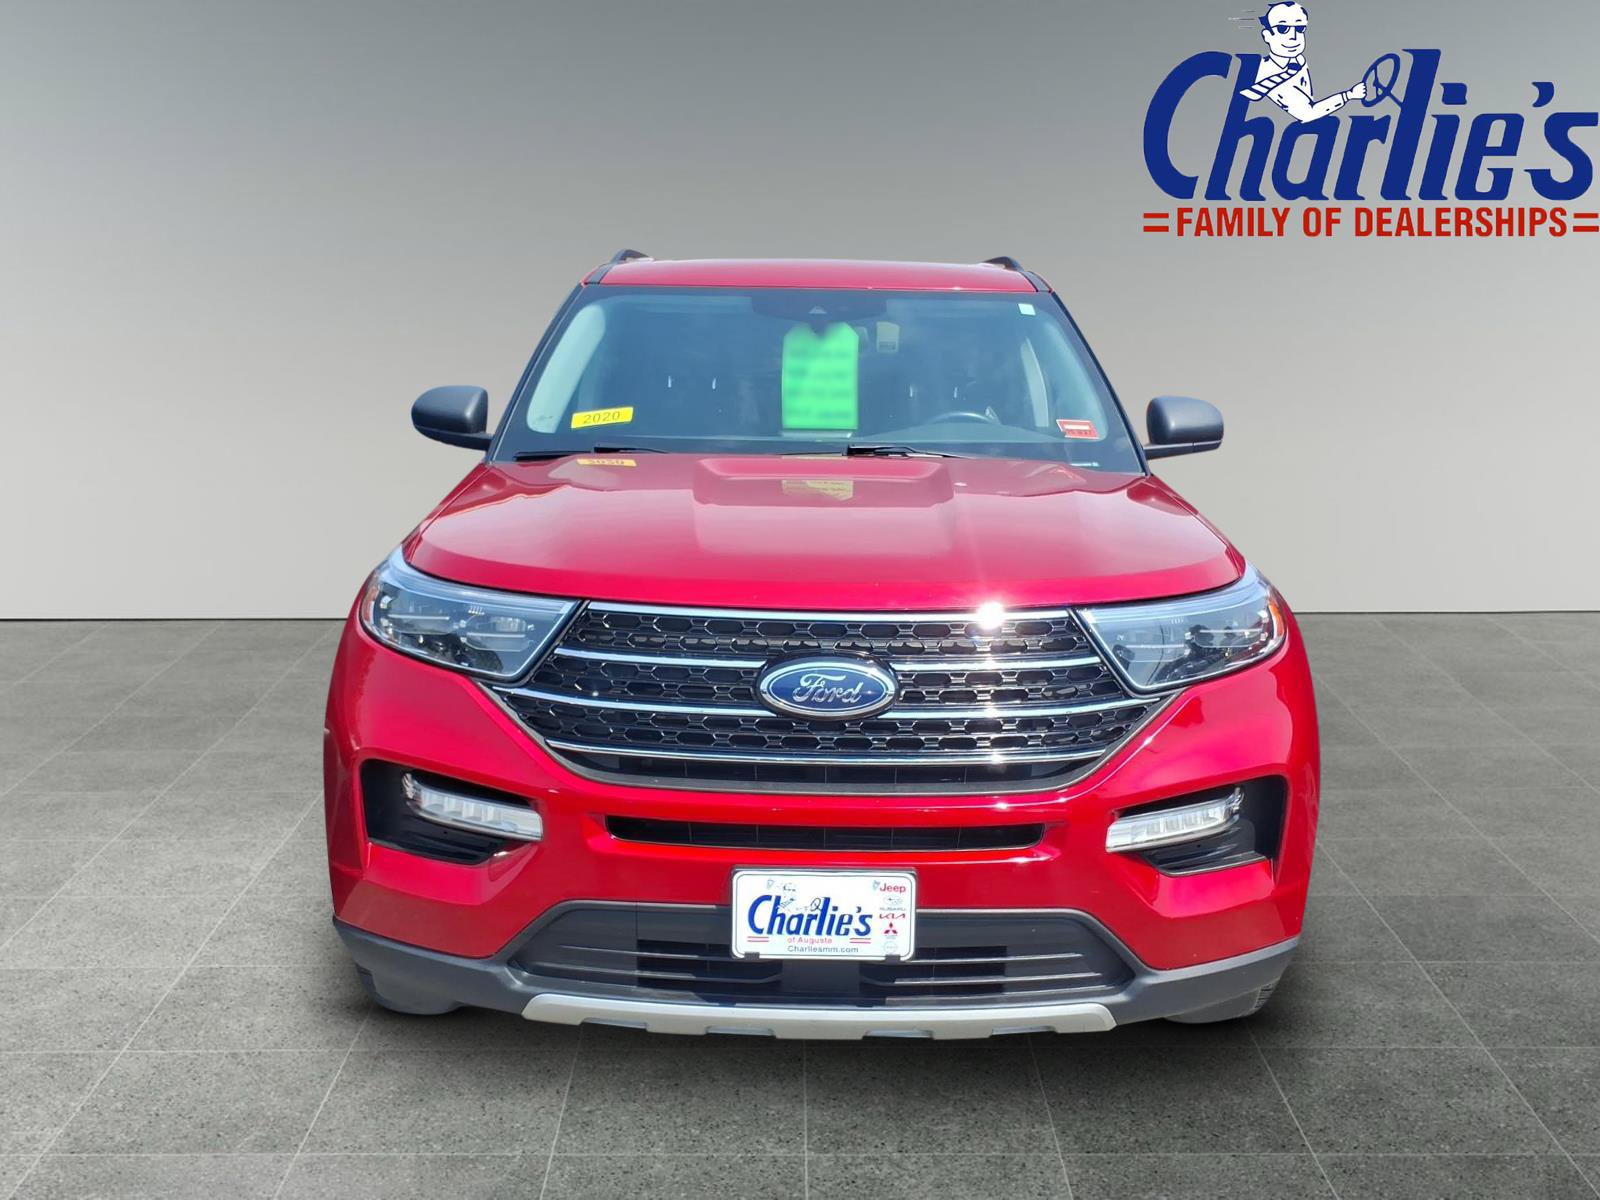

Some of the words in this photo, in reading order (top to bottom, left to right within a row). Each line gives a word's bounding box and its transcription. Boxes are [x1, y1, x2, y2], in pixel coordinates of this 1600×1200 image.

[583, 411, 621, 424] 2020
[792, 673, 864, 703] Ford
[879, 882, 906, 893] Jeep
[747, 894, 873, 936] Charlie's
[786, 936, 796, 944] of
[797, 936, 833, 945] Augusta
